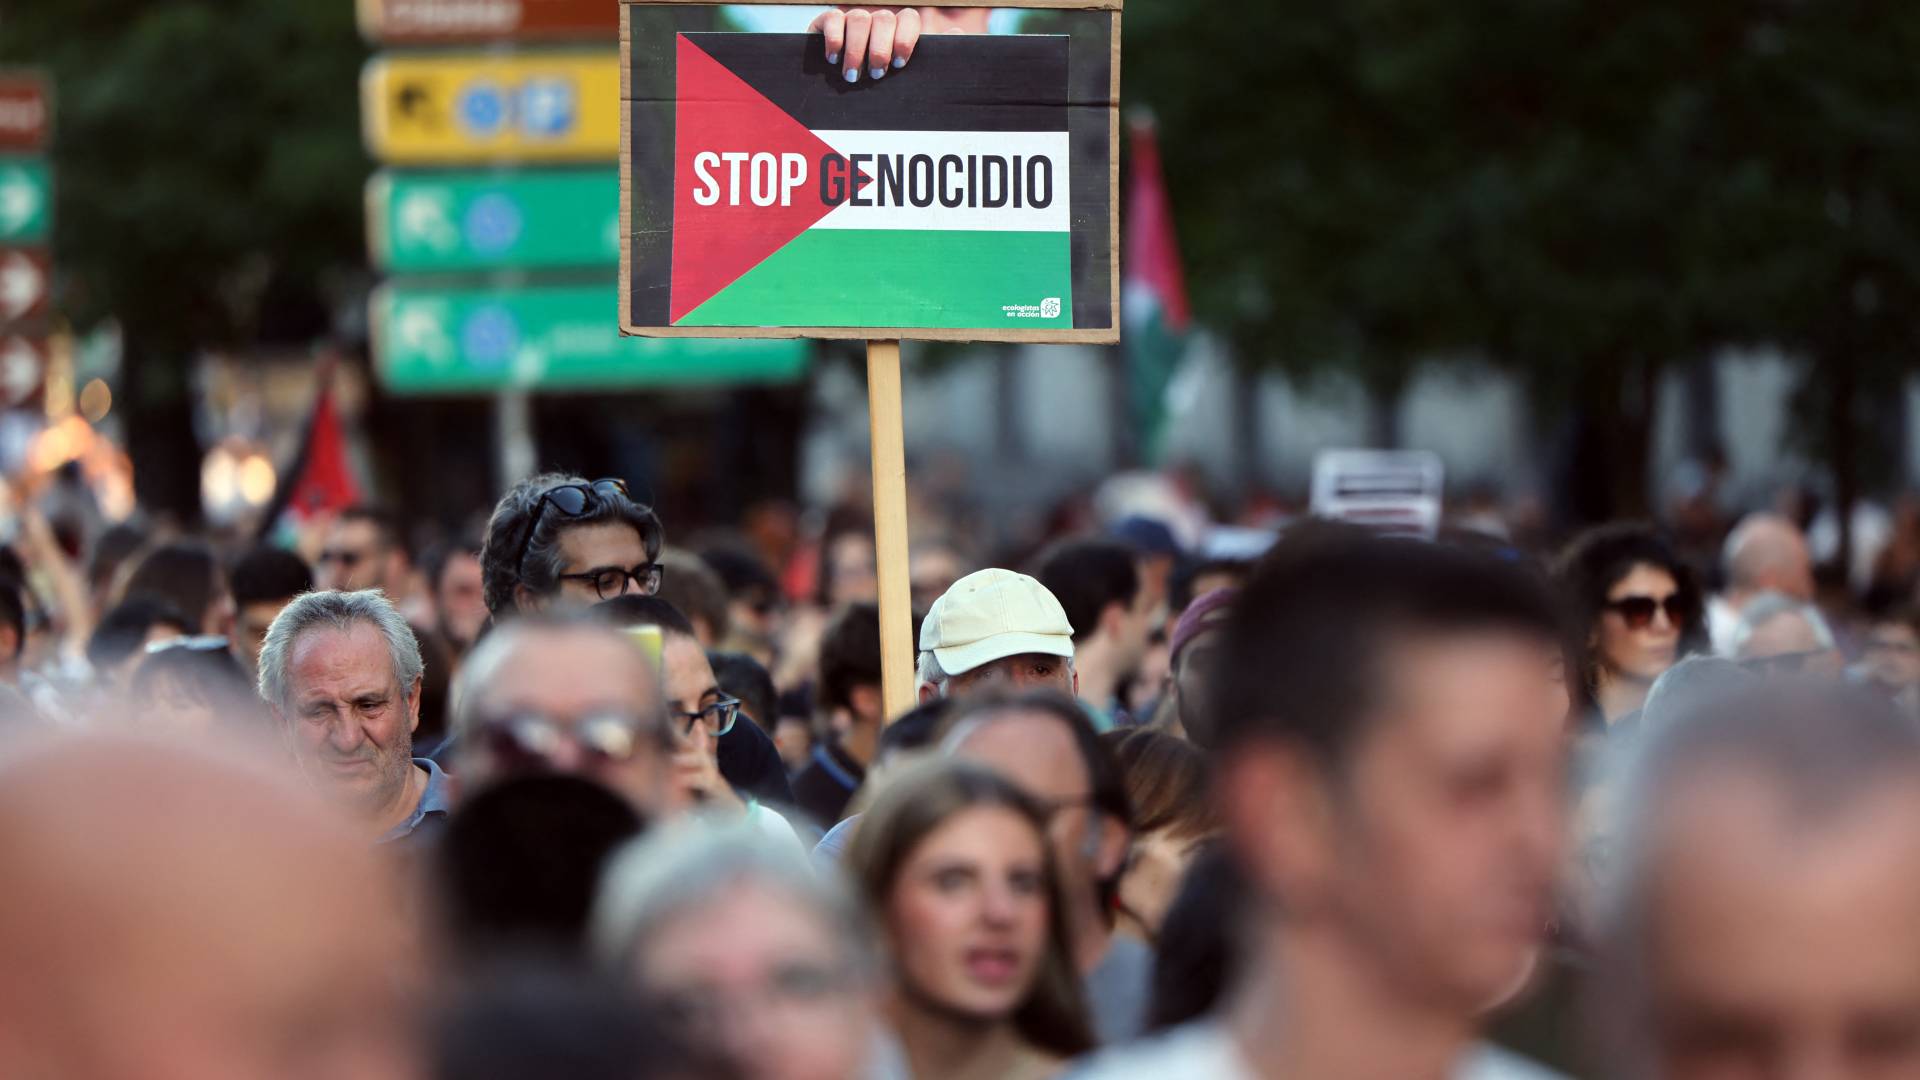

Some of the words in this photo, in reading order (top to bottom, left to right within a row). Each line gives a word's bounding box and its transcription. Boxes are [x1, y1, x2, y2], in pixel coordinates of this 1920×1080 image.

[693, 151, 808, 207] STOP
[819, 153, 1054, 209] GENOCIDIO
[1002, 304, 1040, 312] ecologistas
[1017, 310, 1040, 318] acción
